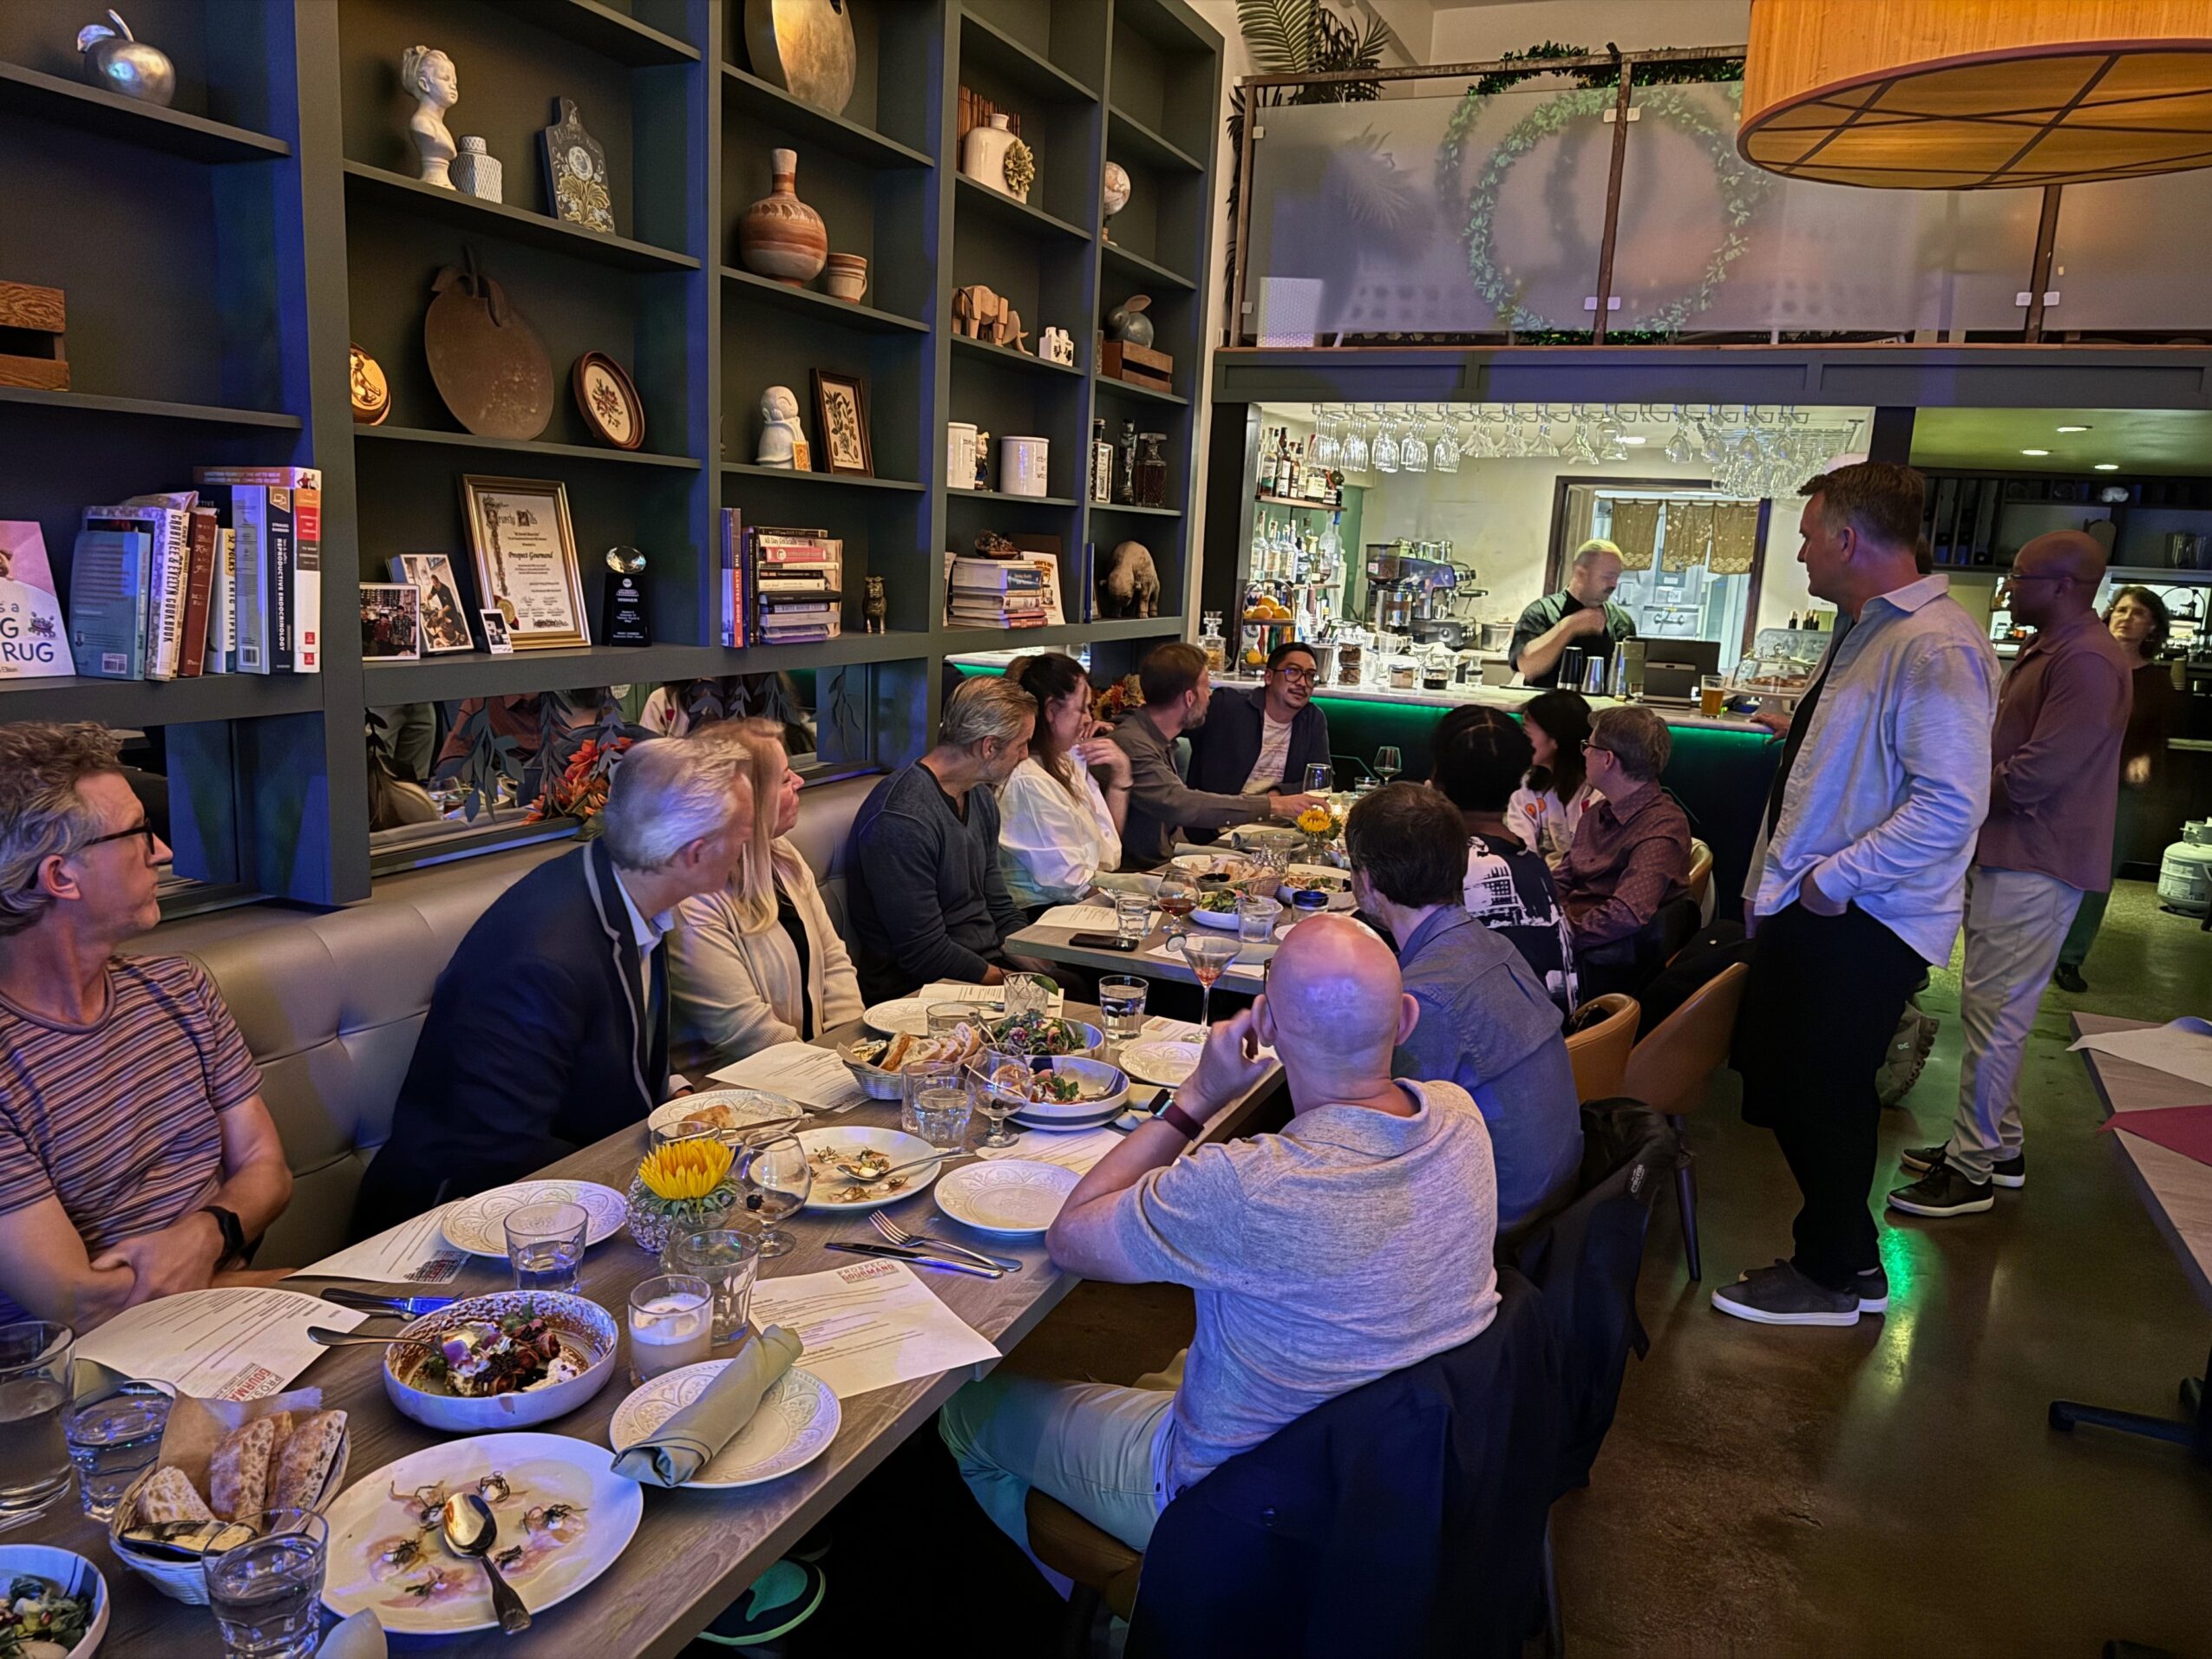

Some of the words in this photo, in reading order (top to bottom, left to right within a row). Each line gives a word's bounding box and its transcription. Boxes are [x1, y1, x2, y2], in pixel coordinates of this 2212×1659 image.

[167, 515, 182, 557] CRABTREE
[165, 565, 180, 596] EVELYN
[163, 598, 177, 643] COOKBOOK
[2, 643, 54, 663] RUG
[841, 1264, 894, 1282] GOURMAND
[228, 1367, 272, 1402] GOURMA
